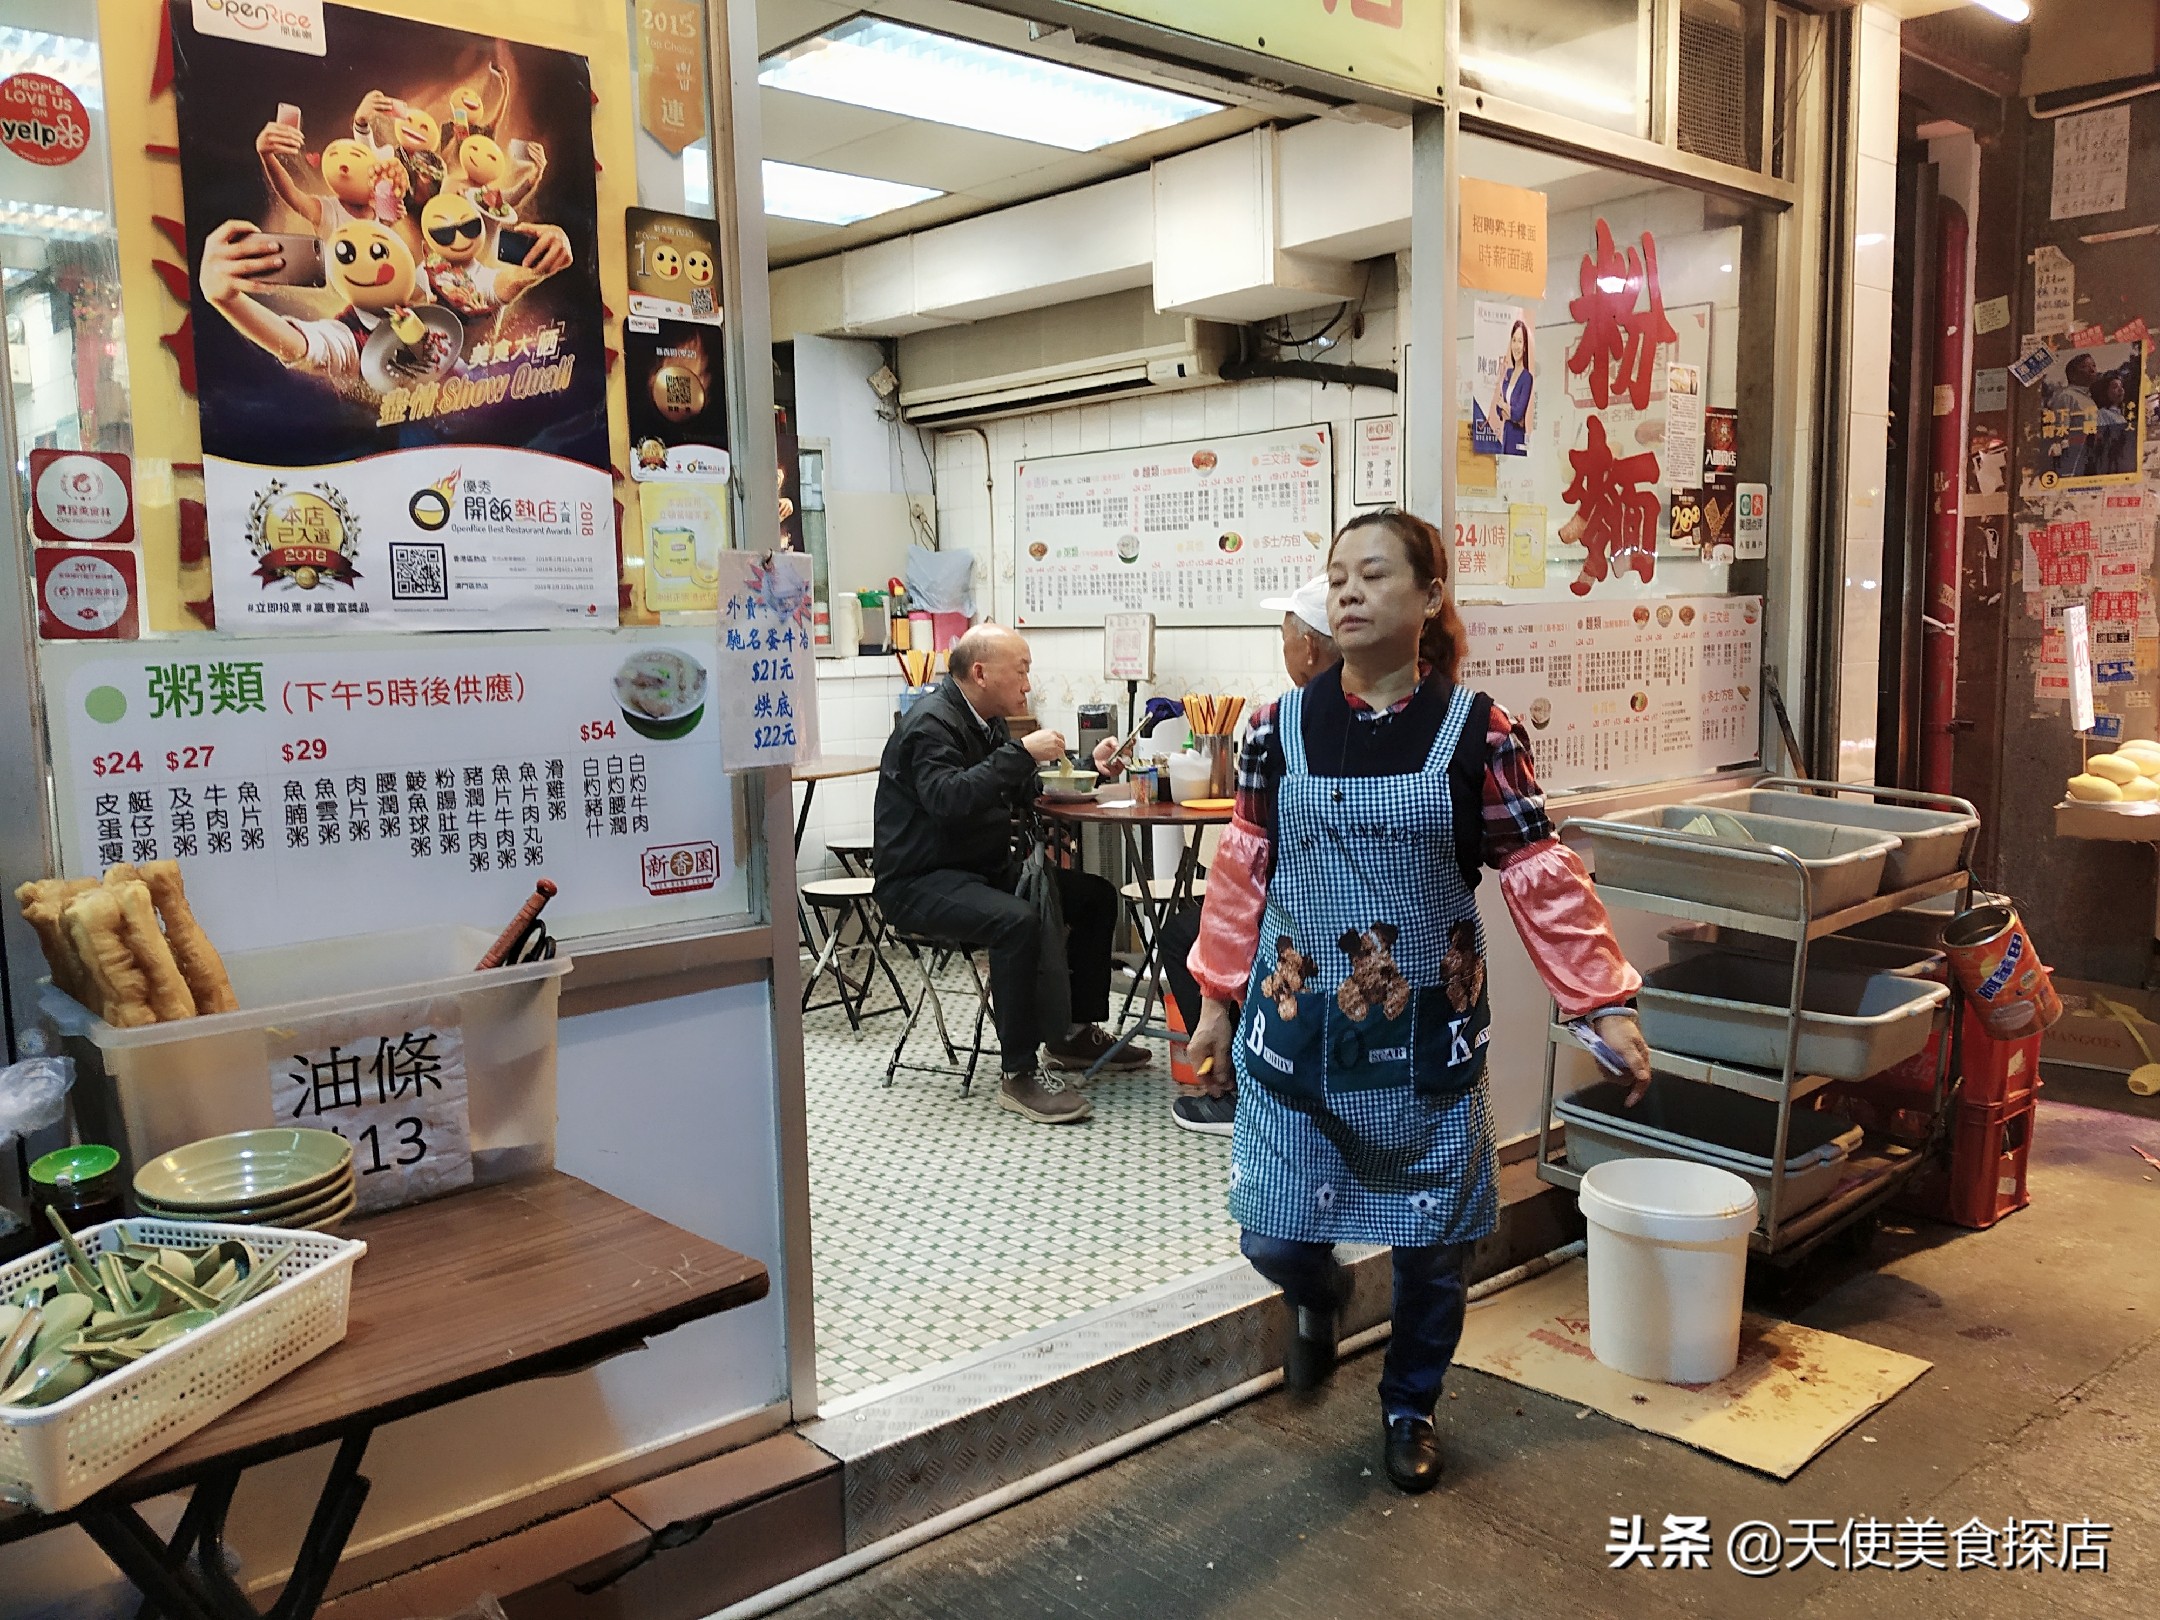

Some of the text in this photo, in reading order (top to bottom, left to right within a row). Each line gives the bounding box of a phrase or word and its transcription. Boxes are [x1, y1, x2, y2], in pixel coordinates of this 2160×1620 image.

[642, 8, 697, 38] 2015
[5, 87, 72, 112] LOVE US
[13, 77, 63, 94] PEOPLE
[31, 107, 48, 118] ON
[1, 119, 57, 147] yelp
[1473, 213, 1537, 241] 招聘熟手樓面
[1478, 244, 1534, 273] 時薪面議
[463, 479, 492, 495] 優秀
[2045, 473, 2055, 485] 3
[281, 504, 325, 526] 本店
[464, 496, 558, 524] 開飯熱店
[580, 501, 594, 537] 2018
[278, 527, 331, 544] 已入選
[451, 523, 572, 536] OpenRice Best Restaurant Awards
[1455, 522, 1506, 549] 24小時
[1458, 550, 1487, 574] 營業
[751, 657, 794, 683] $21元
[145, 662, 525, 719] 粥類 (下午5時後供應)
[754, 690, 794, 719] 烘底
[93, 720, 617, 777] $24 $27 $29 $54
[754, 722, 797, 751] $22元
[629, 753, 649, 833] 白灼牛肉
[204, 784, 232, 854] 牛肉粥
[238, 781, 265, 851] 魚片粥
[315, 777, 340, 845] 魚雲粥
[346, 775, 371, 841] 肉片粥
[491, 764, 517, 869] 魚片牛肉粥
[95, 793, 126, 877] 皮蛋瘦
[128, 790, 158, 861] 艇仔粥
[288, 1031, 443, 1118] 油條
